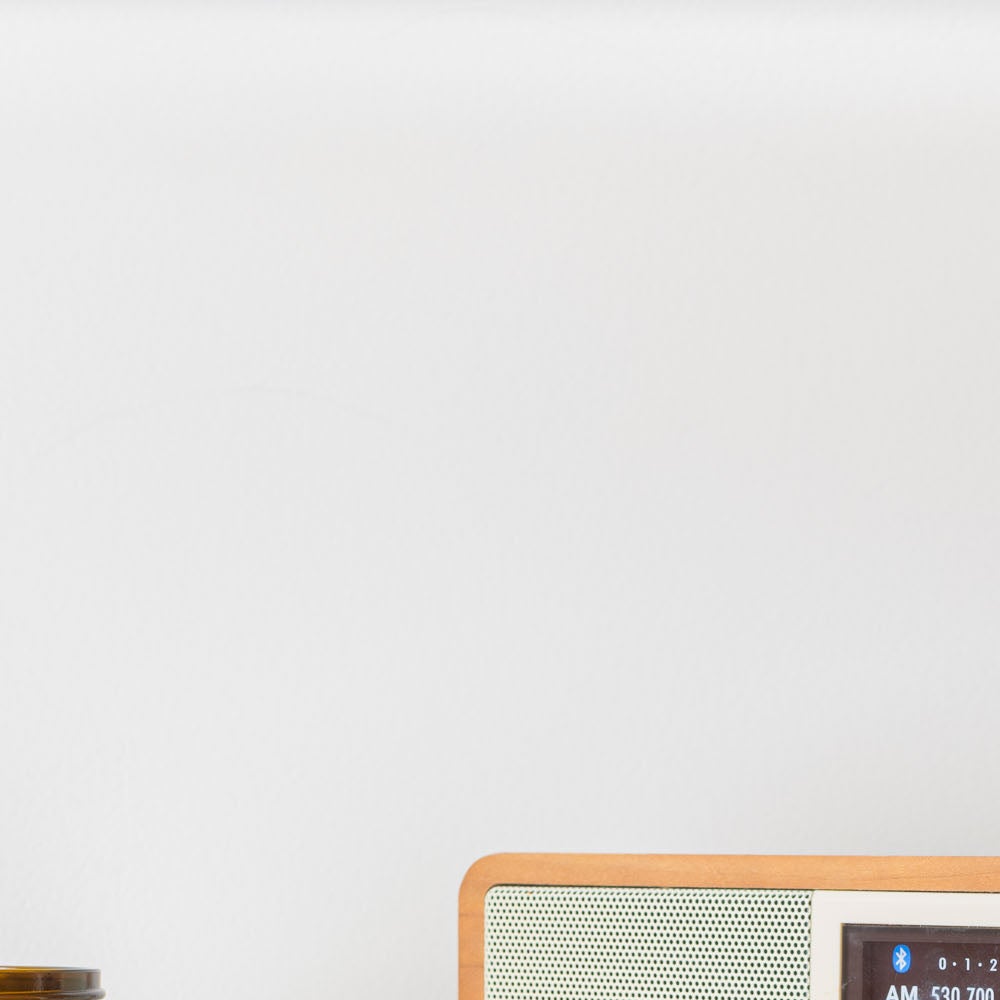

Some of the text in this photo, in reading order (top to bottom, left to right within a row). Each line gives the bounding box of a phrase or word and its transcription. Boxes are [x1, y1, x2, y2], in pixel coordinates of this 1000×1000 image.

[938, 957, 998, 972] 0 1 2
